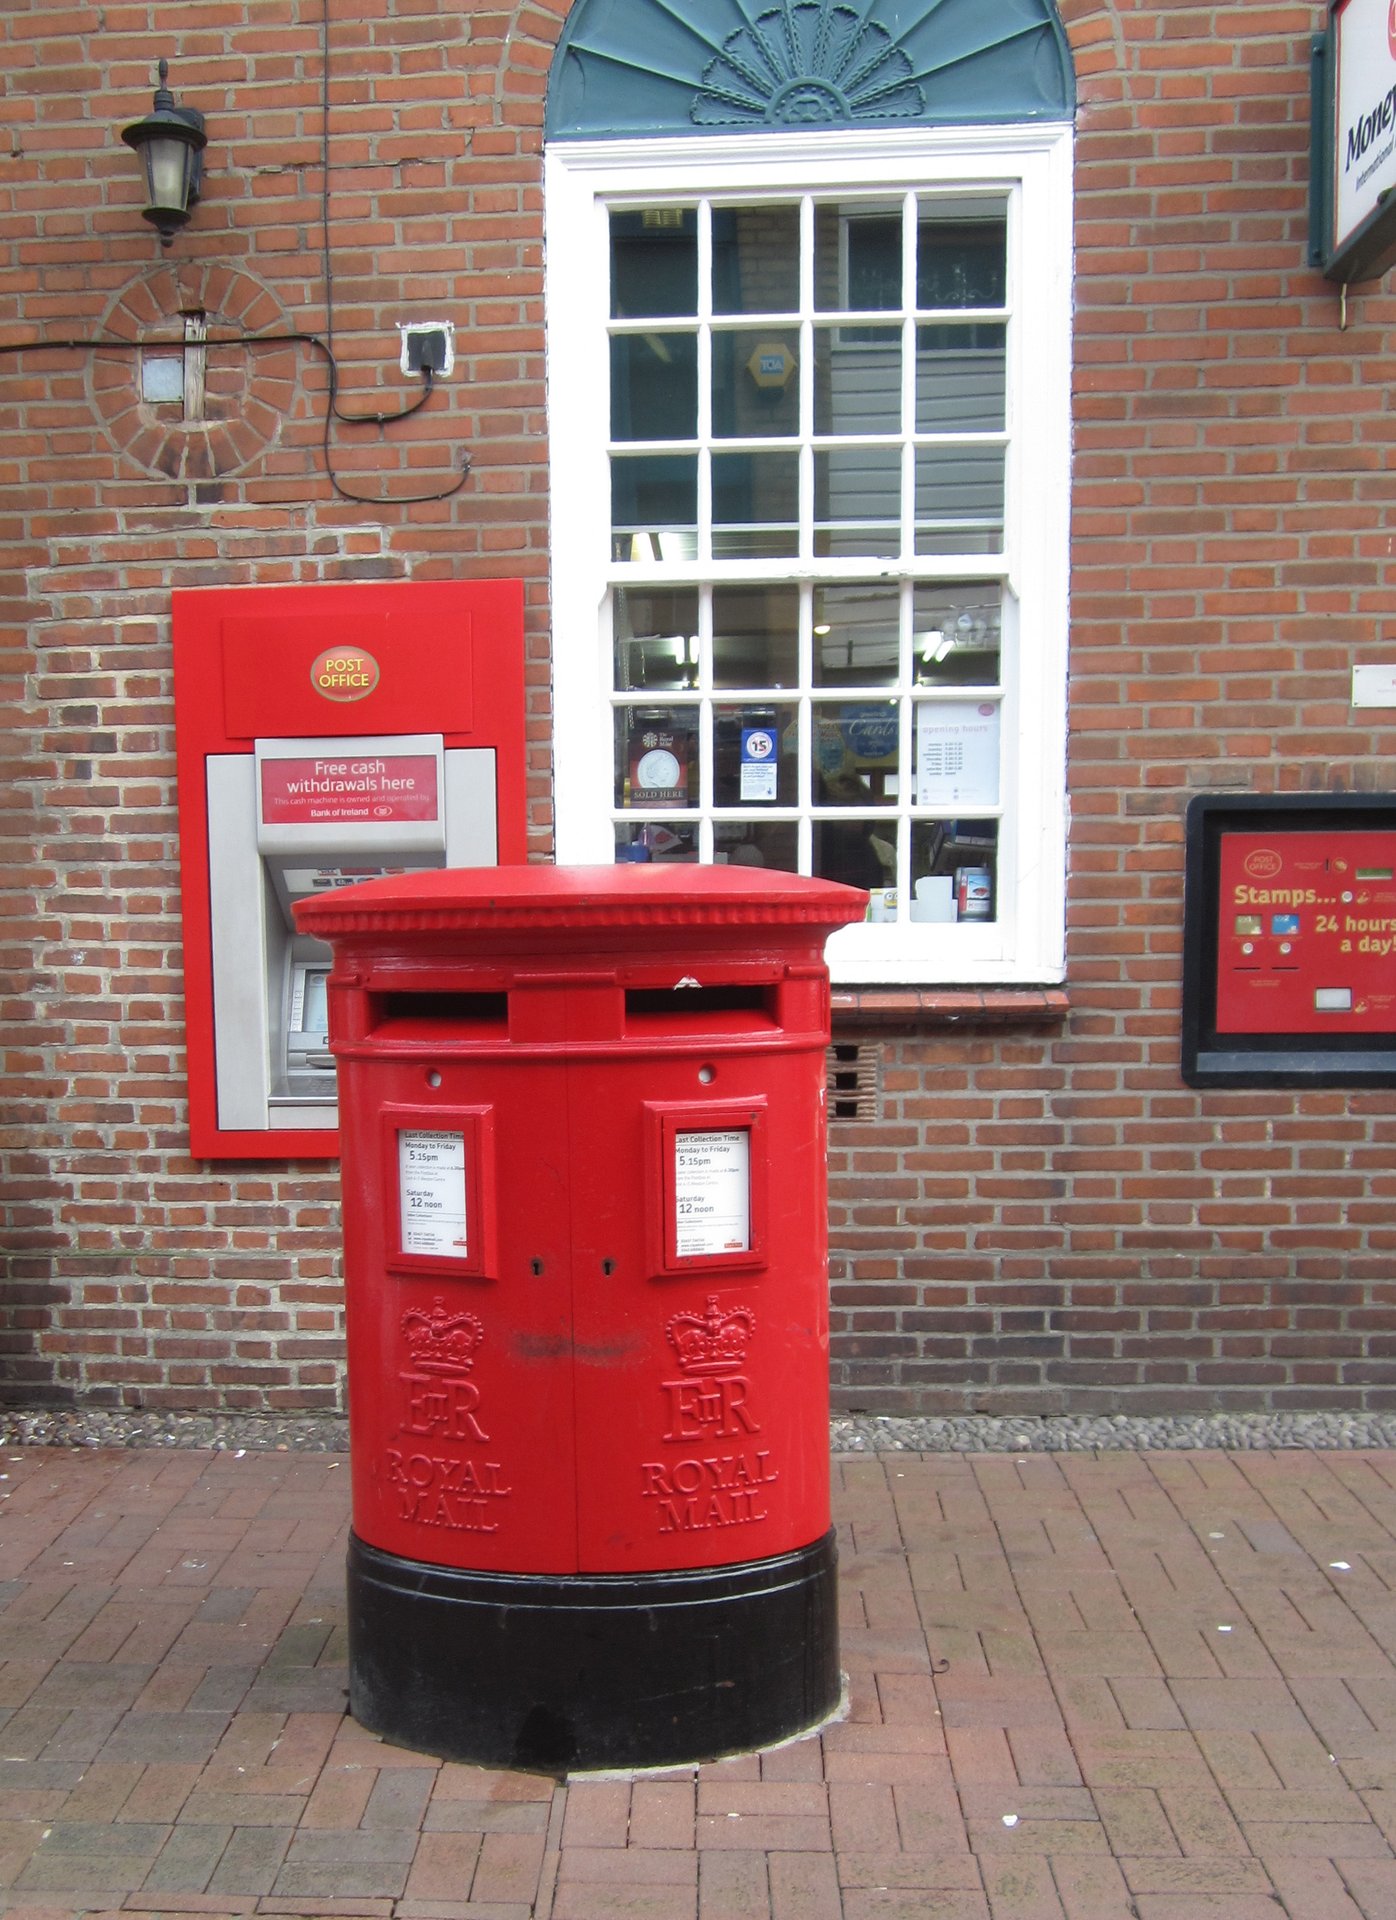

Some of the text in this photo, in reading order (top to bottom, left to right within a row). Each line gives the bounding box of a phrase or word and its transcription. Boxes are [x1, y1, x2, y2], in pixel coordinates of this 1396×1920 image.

[326, 659, 364, 672] POST
[319, 674, 369, 687] OFFICE
[752, 740, 766, 751] 15
[315, 760, 385, 775] Free cash
[287, 776, 415, 793] withdrawals here
[275, 797, 289, 805] This
[290, 797, 306, 805] cash
[307, 796, 337, 804] machine
[346, 795, 370, 803] owned
[660, 790, 684, 798] HERE
[311, 808, 368, 817] Bank of Ireland
[1235, 885, 1337, 908] Stamps...
[1315, 915, 1339, 932] 24
[1340, 939, 1352, 952] a
[405, 1142, 428, 1150] Monday
[437, 1143, 456, 1151] Friday
[410, 1150, 439, 1161] 5.15pm
[679, 1155, 711, 1166] 5.15pm
[406, 1189, 434, 1197] Saturday
[410, 1197, 423, 1207] 12
[679, 1203, 692, 1213] 12
[387, 1448, 513, 1496] ROYAL
[642, 1450, 779, 1496] ROYAL
[398, 1487, 499, 1533] MAIL
[658, 1488, 768, 1533] MAIL
